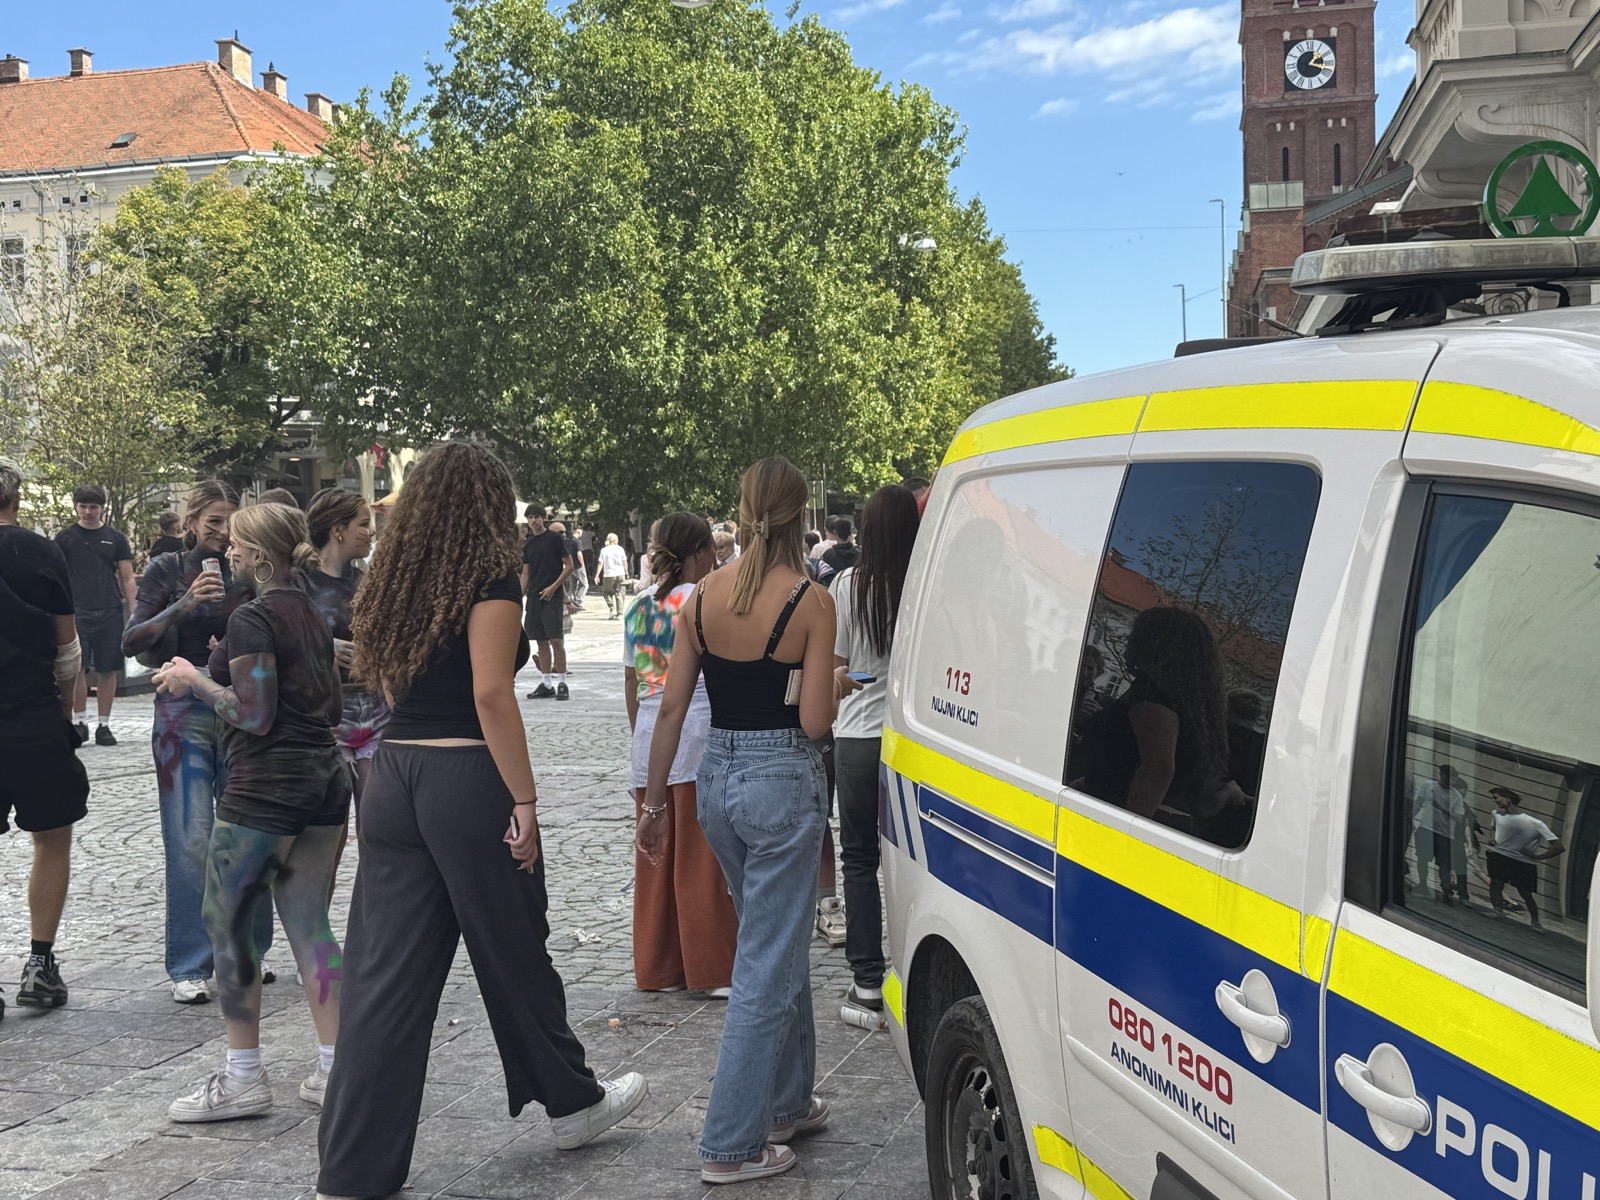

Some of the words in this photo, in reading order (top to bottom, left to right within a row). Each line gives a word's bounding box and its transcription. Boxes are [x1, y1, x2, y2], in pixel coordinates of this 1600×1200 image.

[931, 696, 956, 718] NUJNI
[956, 705, 979, 727] KLICI
[946, 667, 971, 696] 113
[1108, 997, 1155, 1053] 080
[1161, 1032, 1233, 1106] 1200
[1111, 1041, 1189, 1112] ANONIMNI
[1191, 1096, 1236, 1145] KLICI
